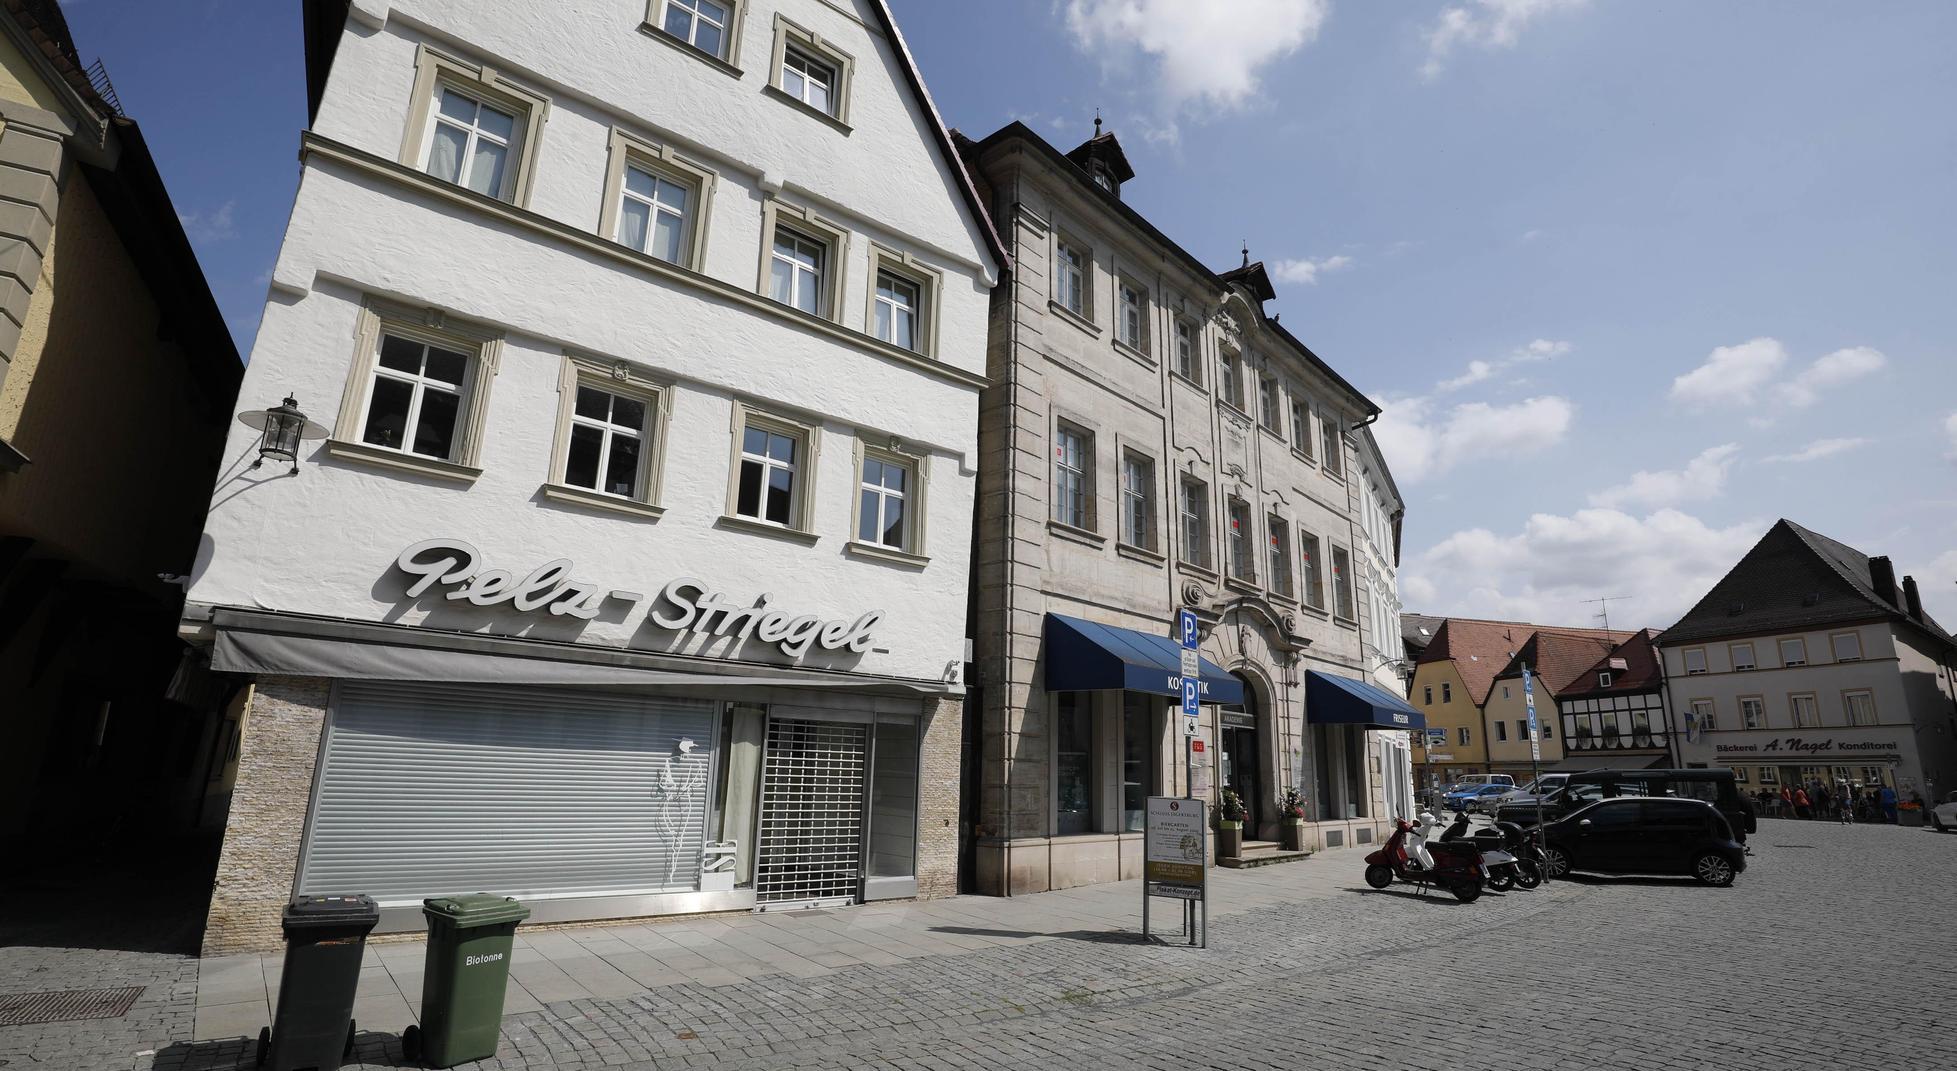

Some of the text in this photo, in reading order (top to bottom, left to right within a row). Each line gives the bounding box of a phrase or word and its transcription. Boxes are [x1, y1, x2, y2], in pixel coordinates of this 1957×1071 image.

[1184, 616, 1194, 643] P
[1185, 682, 1196, 710] P
[1716, 743, 1758, 752] Bäckerei
[1785, 738, 1833, 754] Nagel
[1838, 741, 1897, 751] Konditorei
[465, 952, 503, 966] Biotonne
